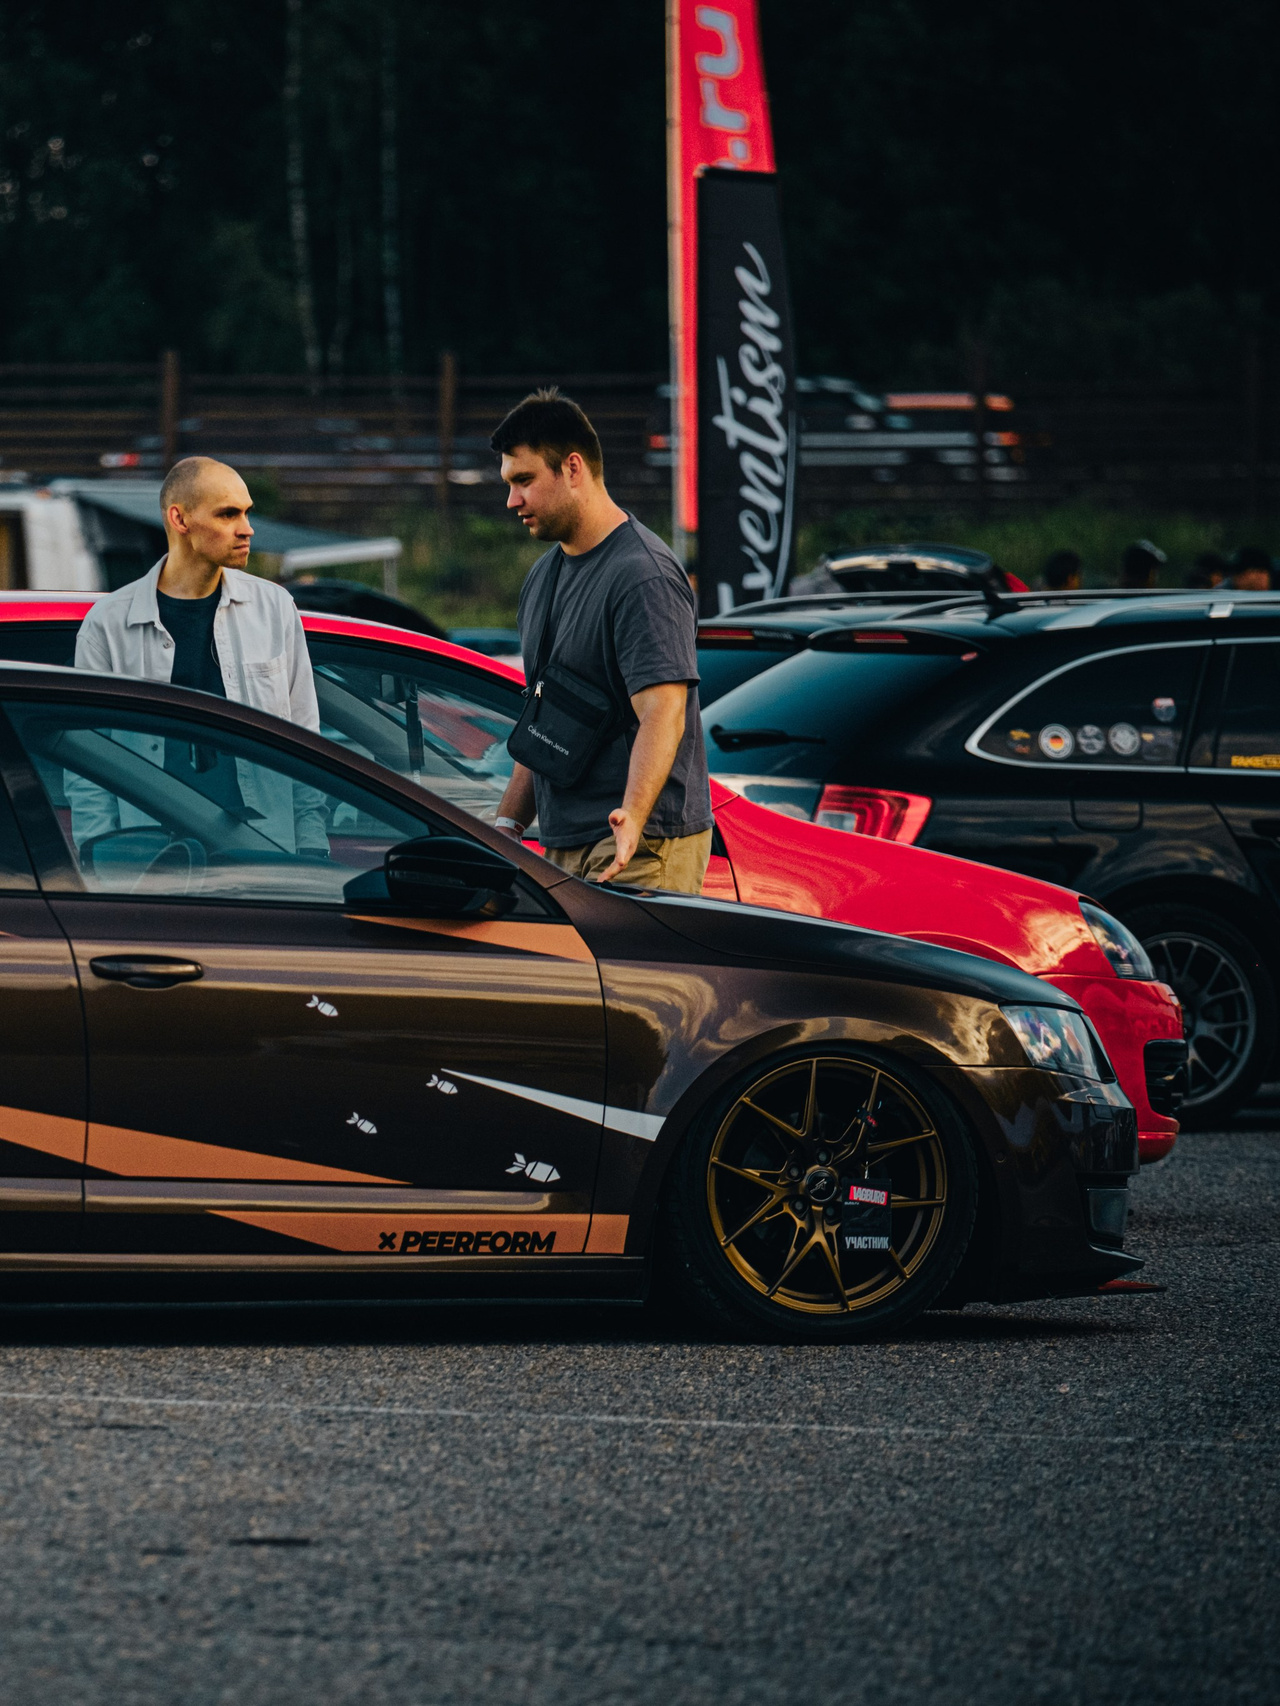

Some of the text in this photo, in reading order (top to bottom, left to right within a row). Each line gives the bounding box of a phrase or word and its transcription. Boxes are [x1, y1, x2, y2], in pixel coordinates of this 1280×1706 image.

[694, 4, 749, 170] .ru
[527, 724, 570, 756] Calvin Klein Jeans
[399, 1230, 557, 1254] PEERFORM
[845, 1236, 889, 1250] УЧАСТНИК
